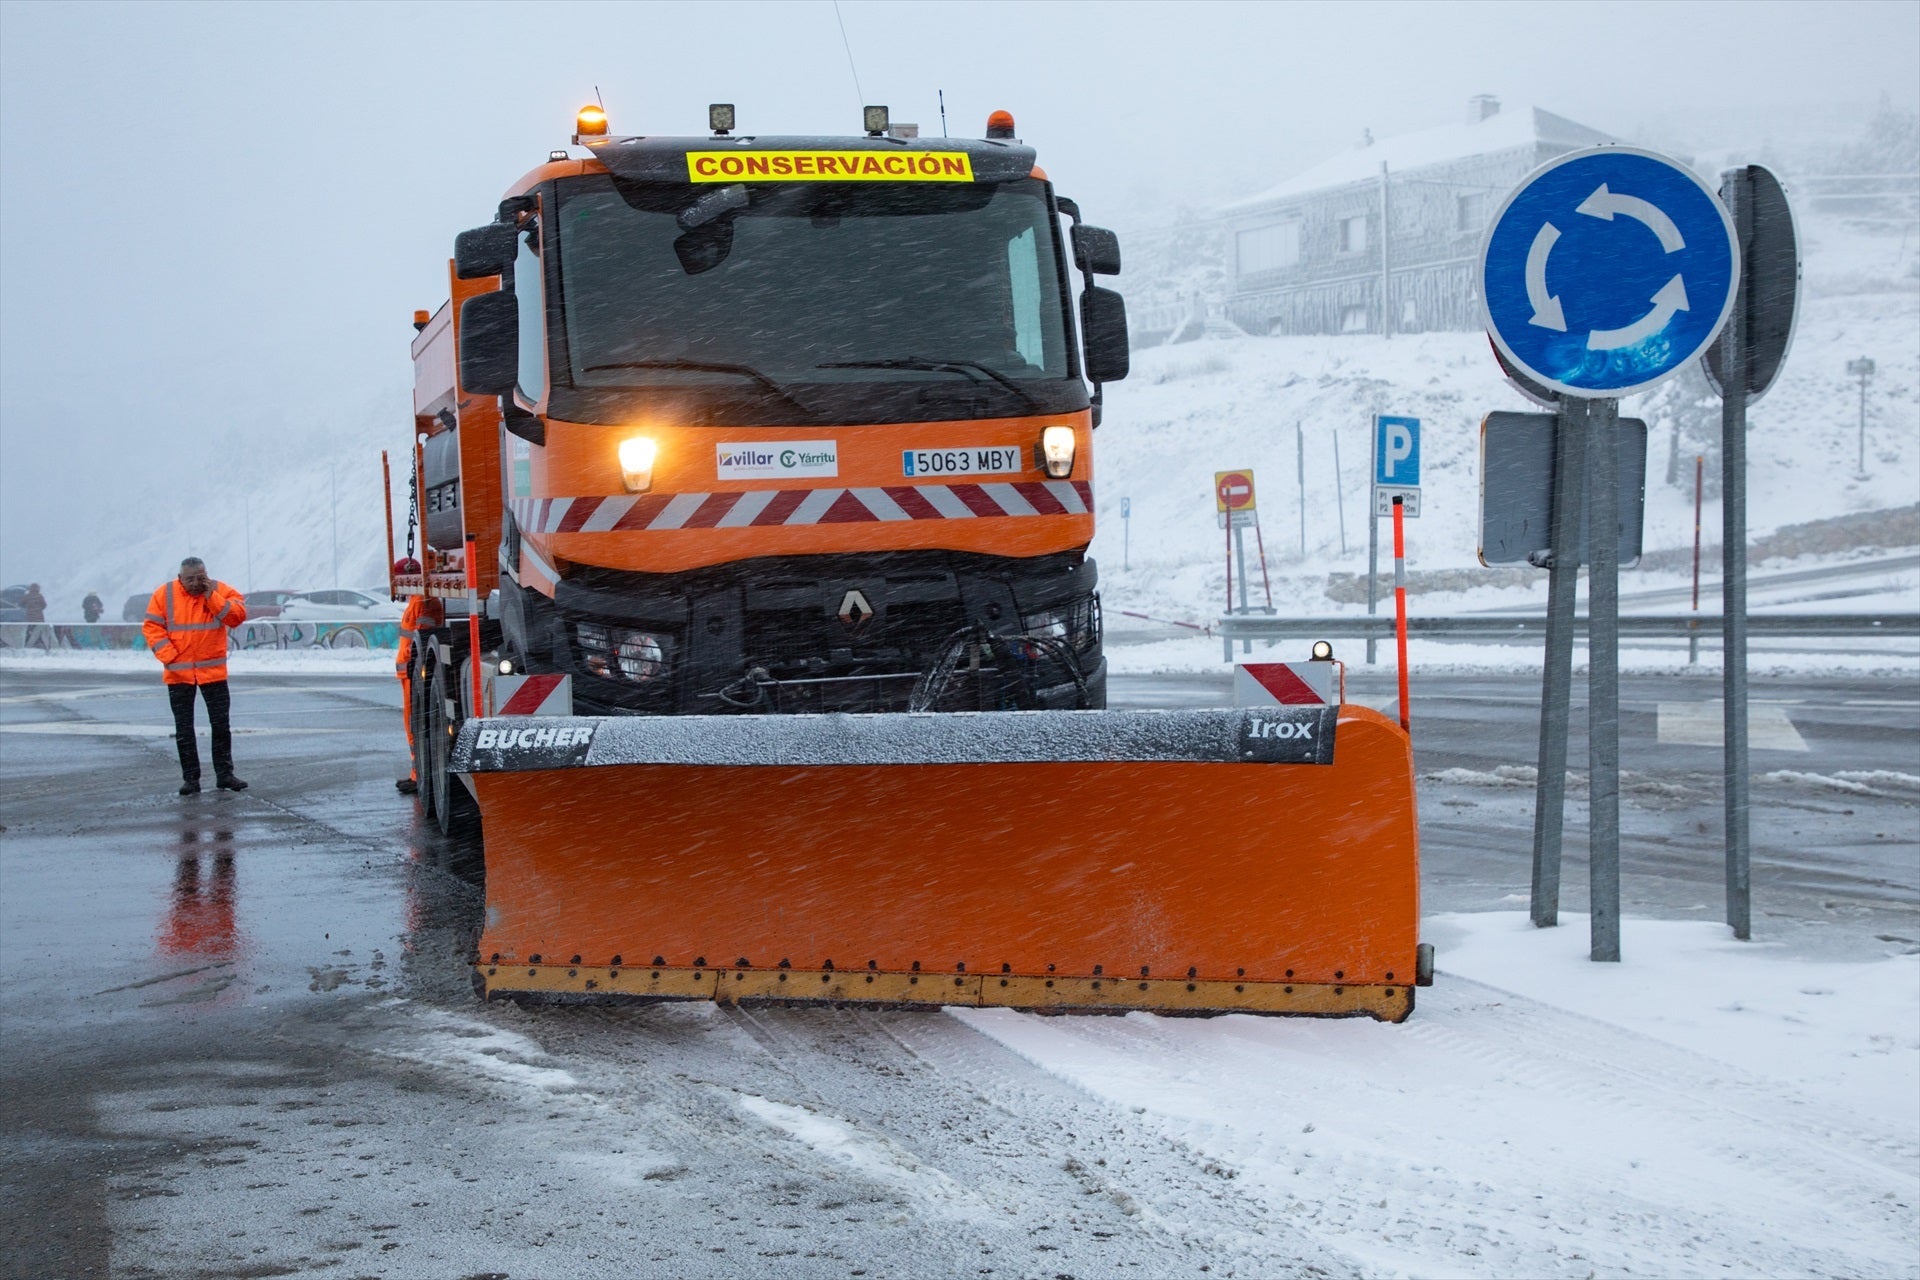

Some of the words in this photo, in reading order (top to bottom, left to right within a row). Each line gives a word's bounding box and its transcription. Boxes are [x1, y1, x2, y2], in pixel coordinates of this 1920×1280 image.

[695, 153, 966, 176] CONSERVACIÓN
[733, 451, 774, 465] villar
[798, 452, 835, 464] Yárritu
[918, 452, 970, 472] 5063
[977, 450, 1014, 470] MBY
[1385, 424, 1412, 477] P
[476, 727, 593, 749] BUCHER
[1248, 719, 1315, 739] Irox
